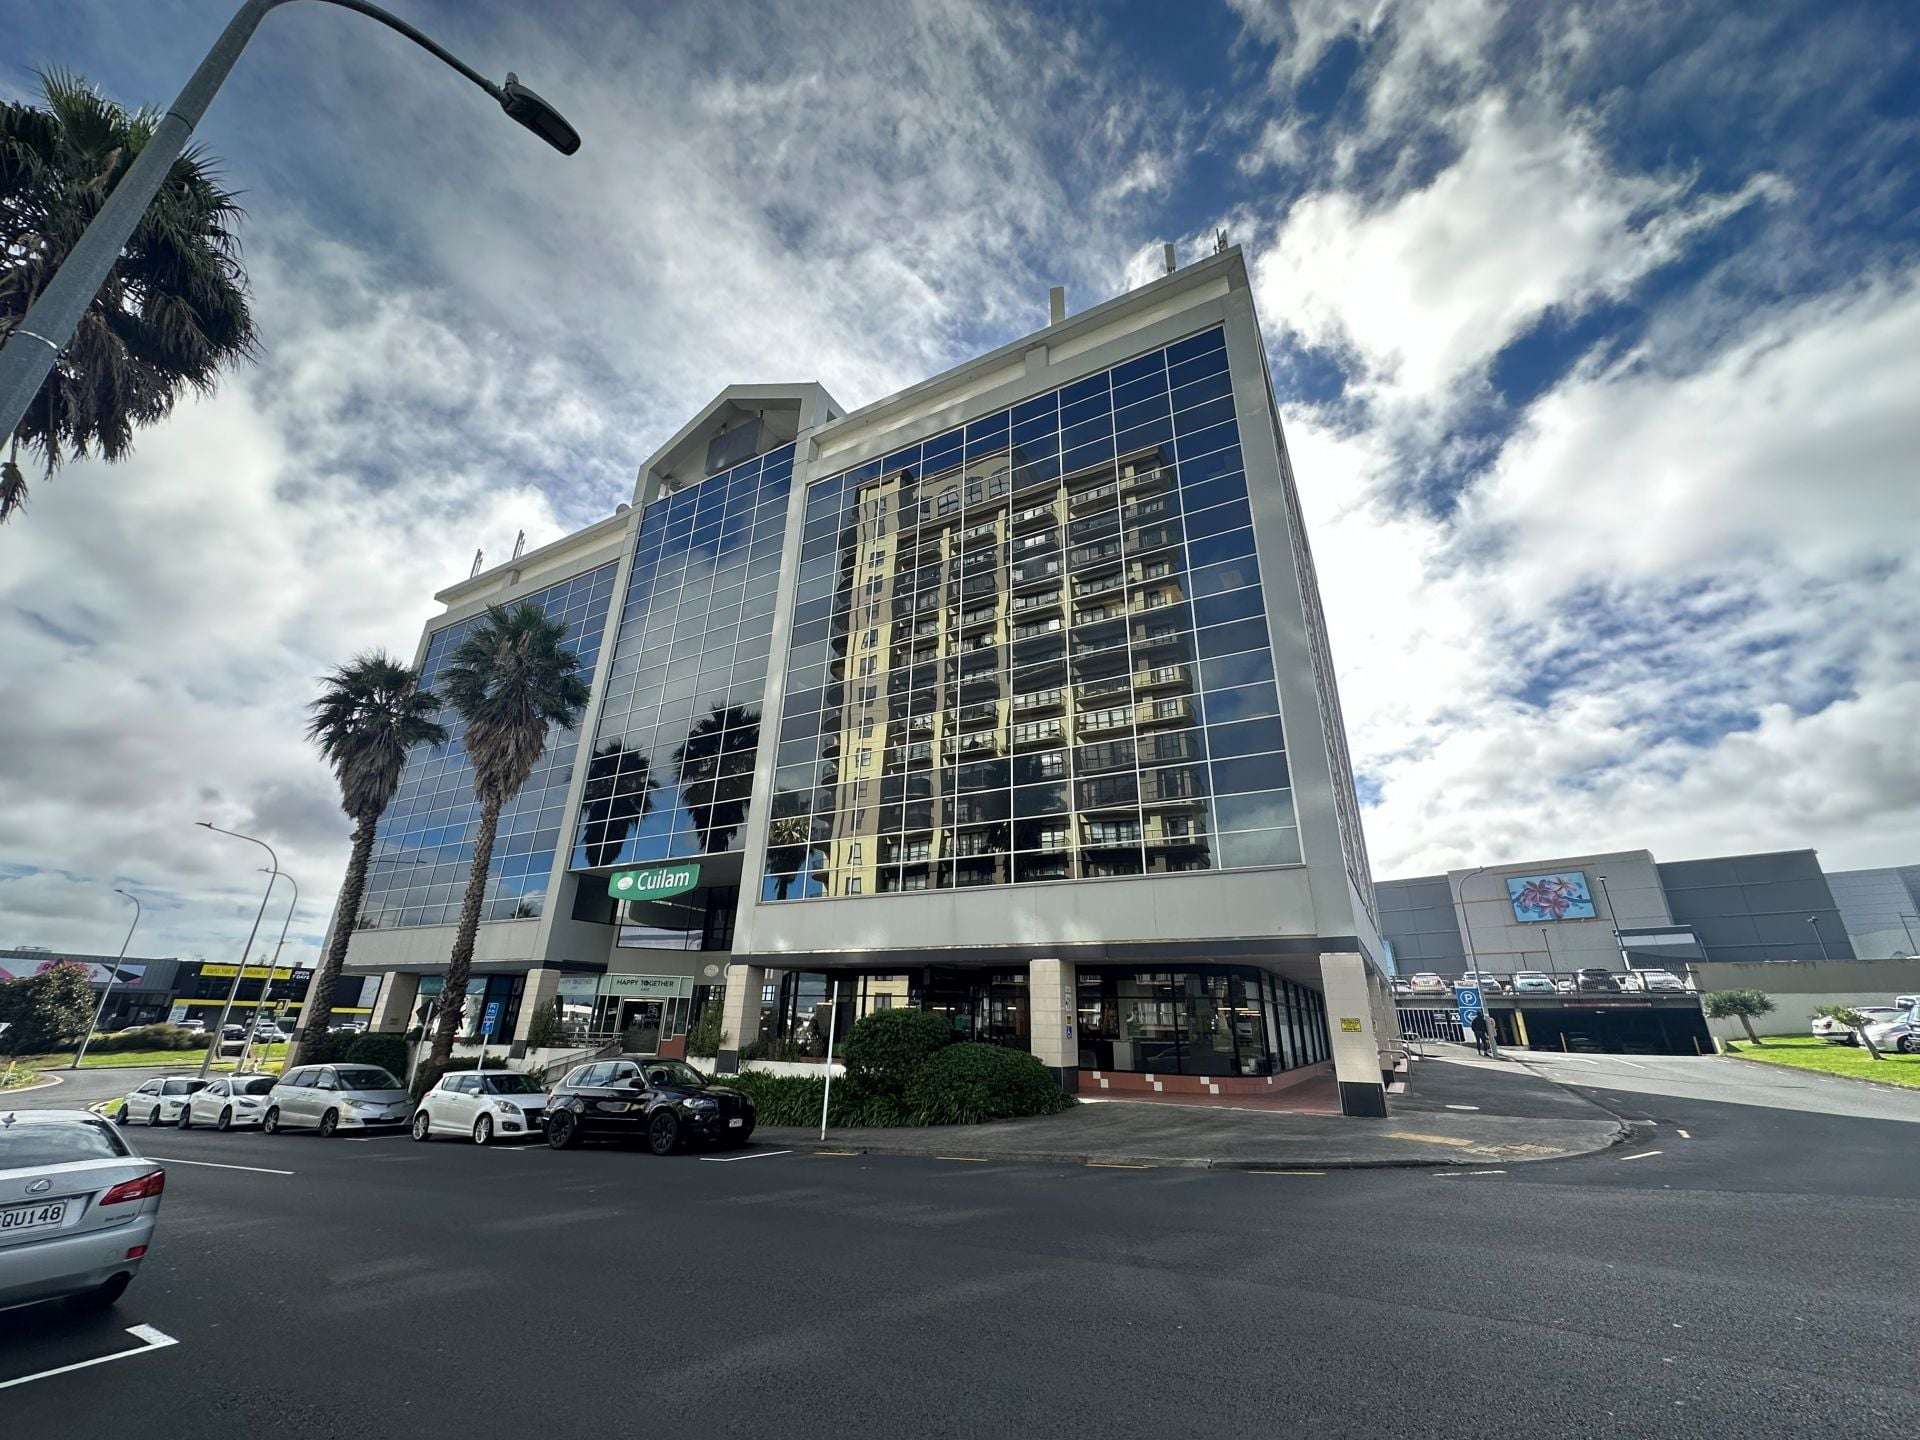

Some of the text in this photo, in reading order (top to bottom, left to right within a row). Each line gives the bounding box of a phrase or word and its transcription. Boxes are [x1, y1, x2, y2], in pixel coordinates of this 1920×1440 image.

[637, 869, 690, 890] Cuilam
[640, 979, 674, 988] TOGETHER
[1463, 993, 1473, 1003] P
